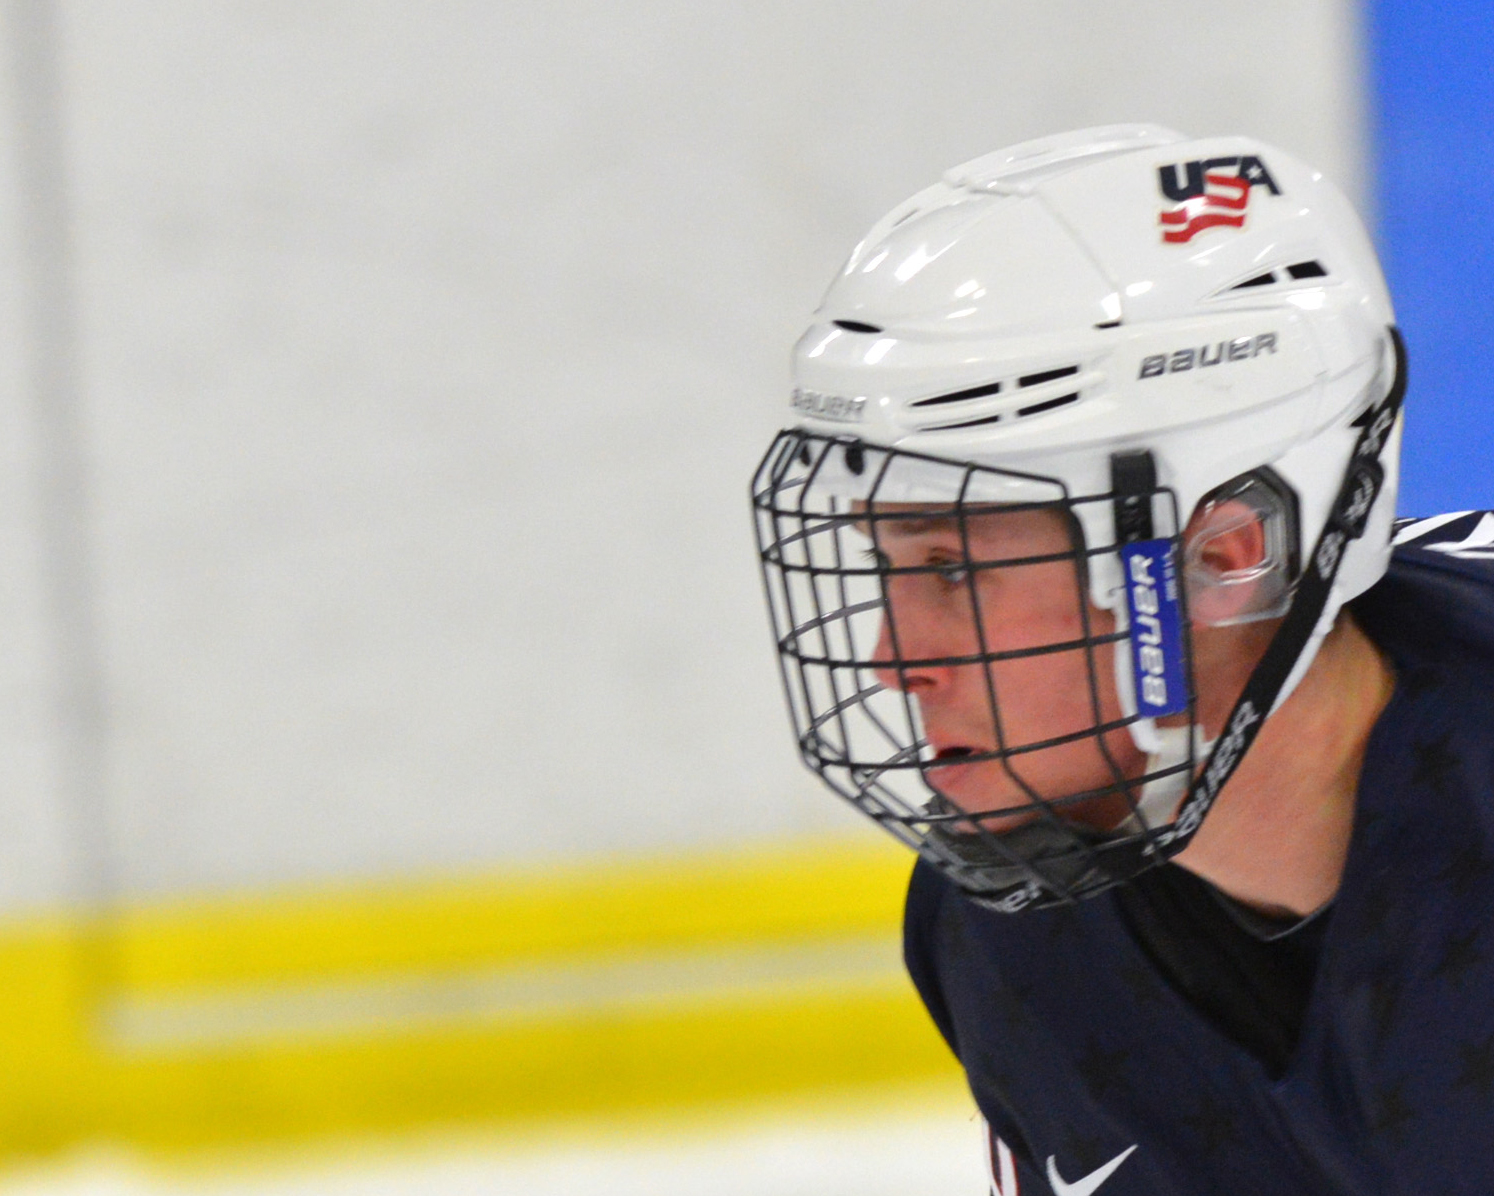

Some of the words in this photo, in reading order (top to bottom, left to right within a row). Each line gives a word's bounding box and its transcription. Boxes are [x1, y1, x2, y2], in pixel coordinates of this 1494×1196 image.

[1156, 154, 1285, 243] USA
[1137, 331, 1279, 380] BAUER
[1129, 554, 1168, 707] BAUER
